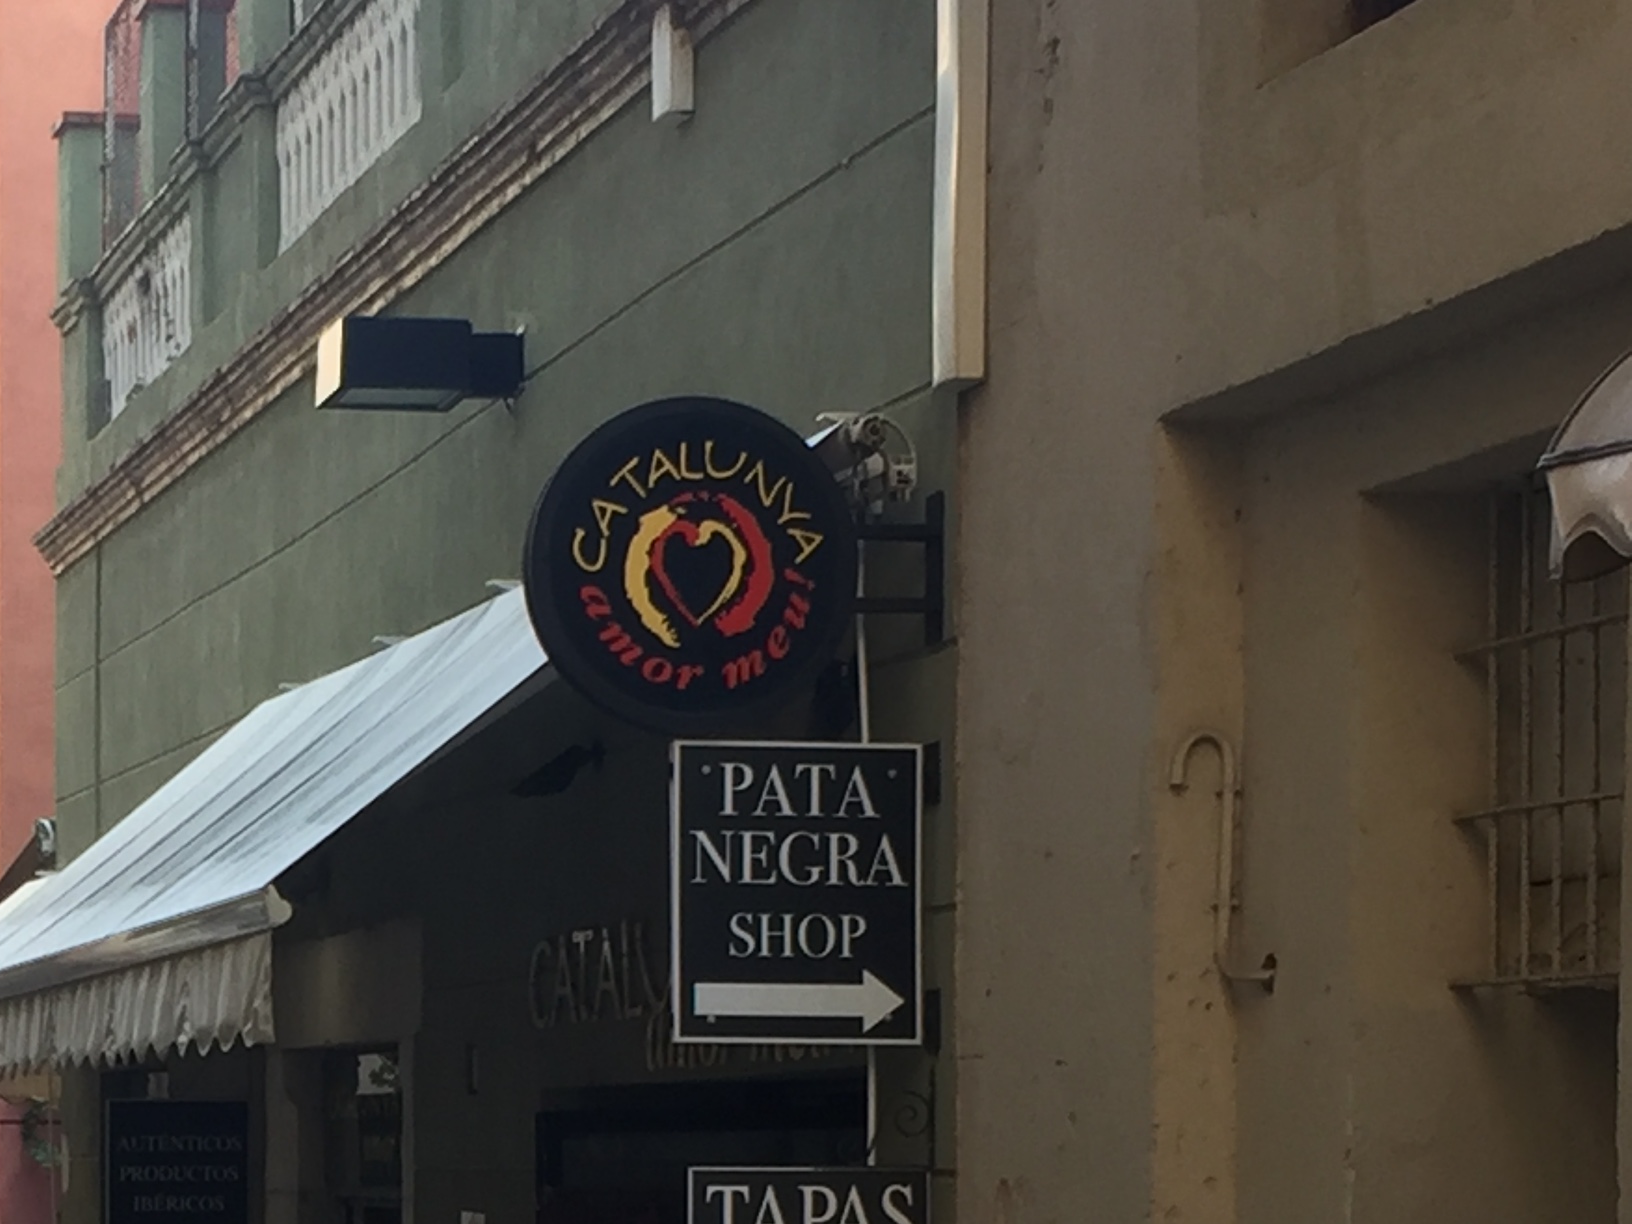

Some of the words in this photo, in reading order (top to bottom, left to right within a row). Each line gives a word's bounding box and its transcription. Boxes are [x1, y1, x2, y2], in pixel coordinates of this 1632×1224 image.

[573, 440, 824, 573] CATALUNYA
[580, 584, 704, 690] amor
[721, 567, 816, 690] meu!
[719, 762, 881, 818] PATA
[689, 830, 909, 887] NEGRA
[728, 912, 867, 958] SHOP
[119, 1164, 240, 1182] PRODUCTOS
